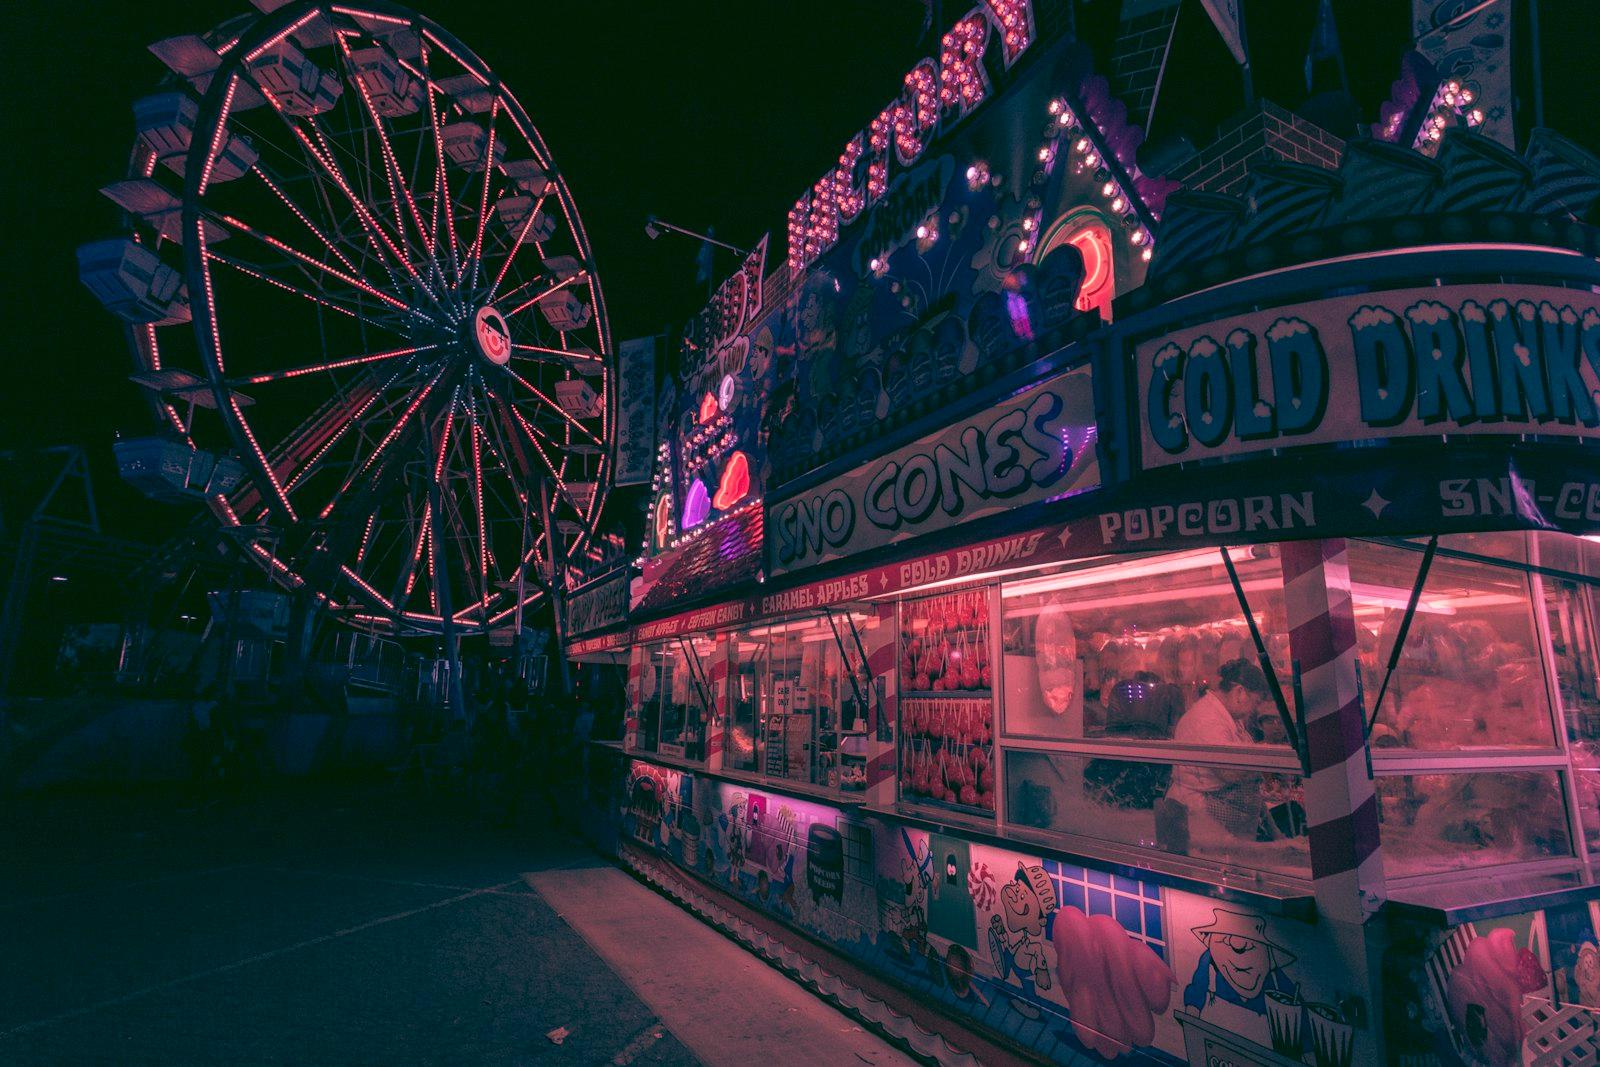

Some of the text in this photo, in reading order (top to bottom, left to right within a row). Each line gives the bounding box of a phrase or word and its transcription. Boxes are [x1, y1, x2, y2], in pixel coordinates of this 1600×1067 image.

[1148, 317, 1329, 454] COLD
[778, 392, 1072, 564] SNO CONES
[1100, 490, 1316, 544] POPCORN
[900, 532, 1046, 587] COLD DRINKS
[687, 601, 745, 630] COTTON CANDY
[762, 573, 869, 614] CARAMEL APPLES
[637, 618, 679, 641] CANDY APPLES
